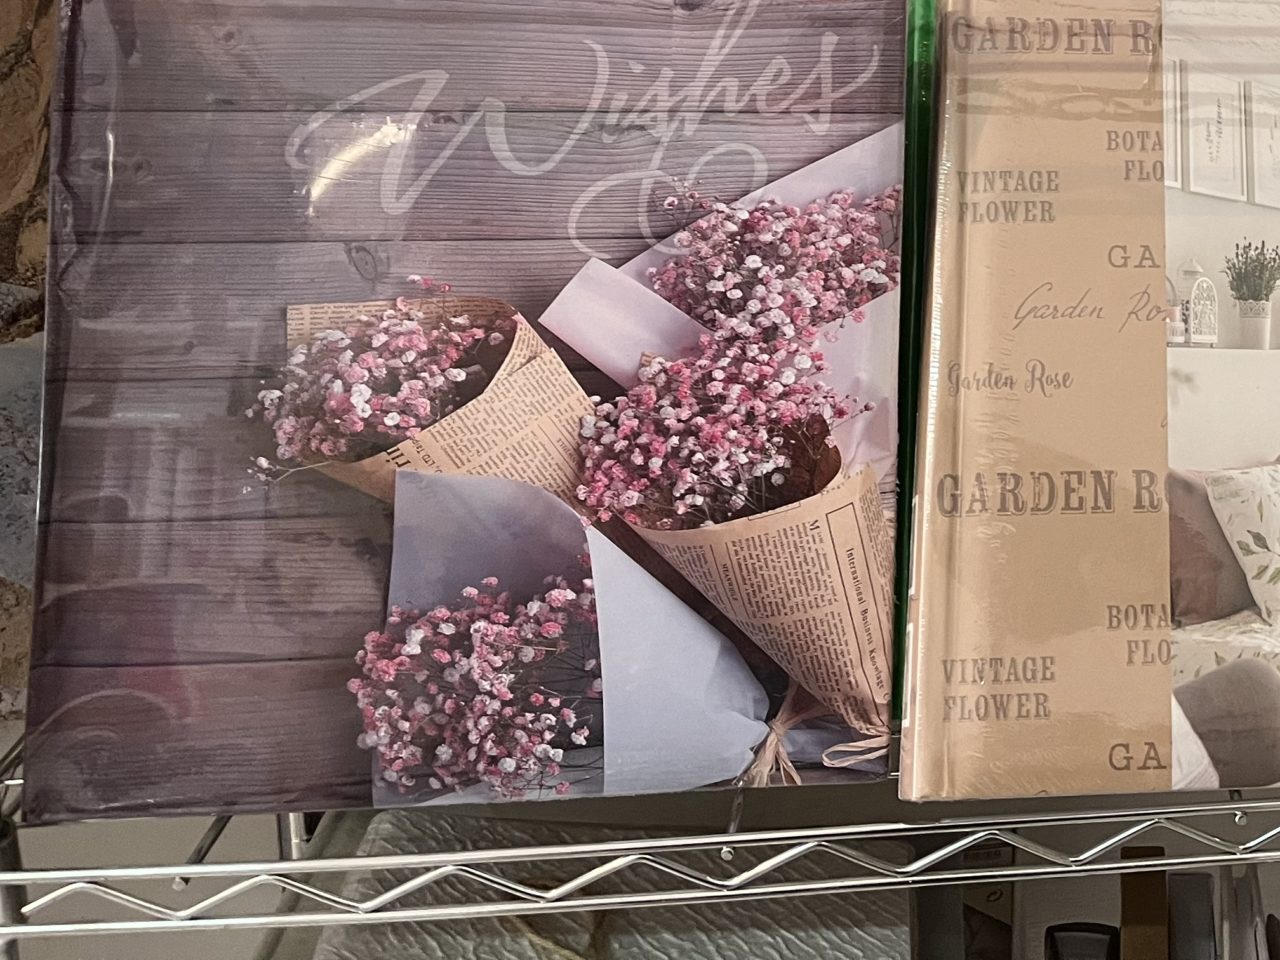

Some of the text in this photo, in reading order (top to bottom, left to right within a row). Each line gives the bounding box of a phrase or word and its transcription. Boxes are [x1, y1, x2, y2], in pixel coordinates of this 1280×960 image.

[952, 16, 1116, 54] GARDEN
[1128, 19, 1162, 55] R
[957, 170, 1060, 194] VINTAGE
[1123, 160, 1164, 181] FLO
[958, 200, 1056, 225] FLOWER
[1108, 245, 1161, 269] GA
[1013, 282, 1105, 331] Garden
[948, 358, 1074, 398] Garden Rose
[937, 470, 1118, 517] GARDEN
[845, 548, 868, 606] International
[941, 655, 1056, 685] VINTAGE
[942, 692, 1052, 722] FLOWER
[1108, 742, 1168, 771] GA
